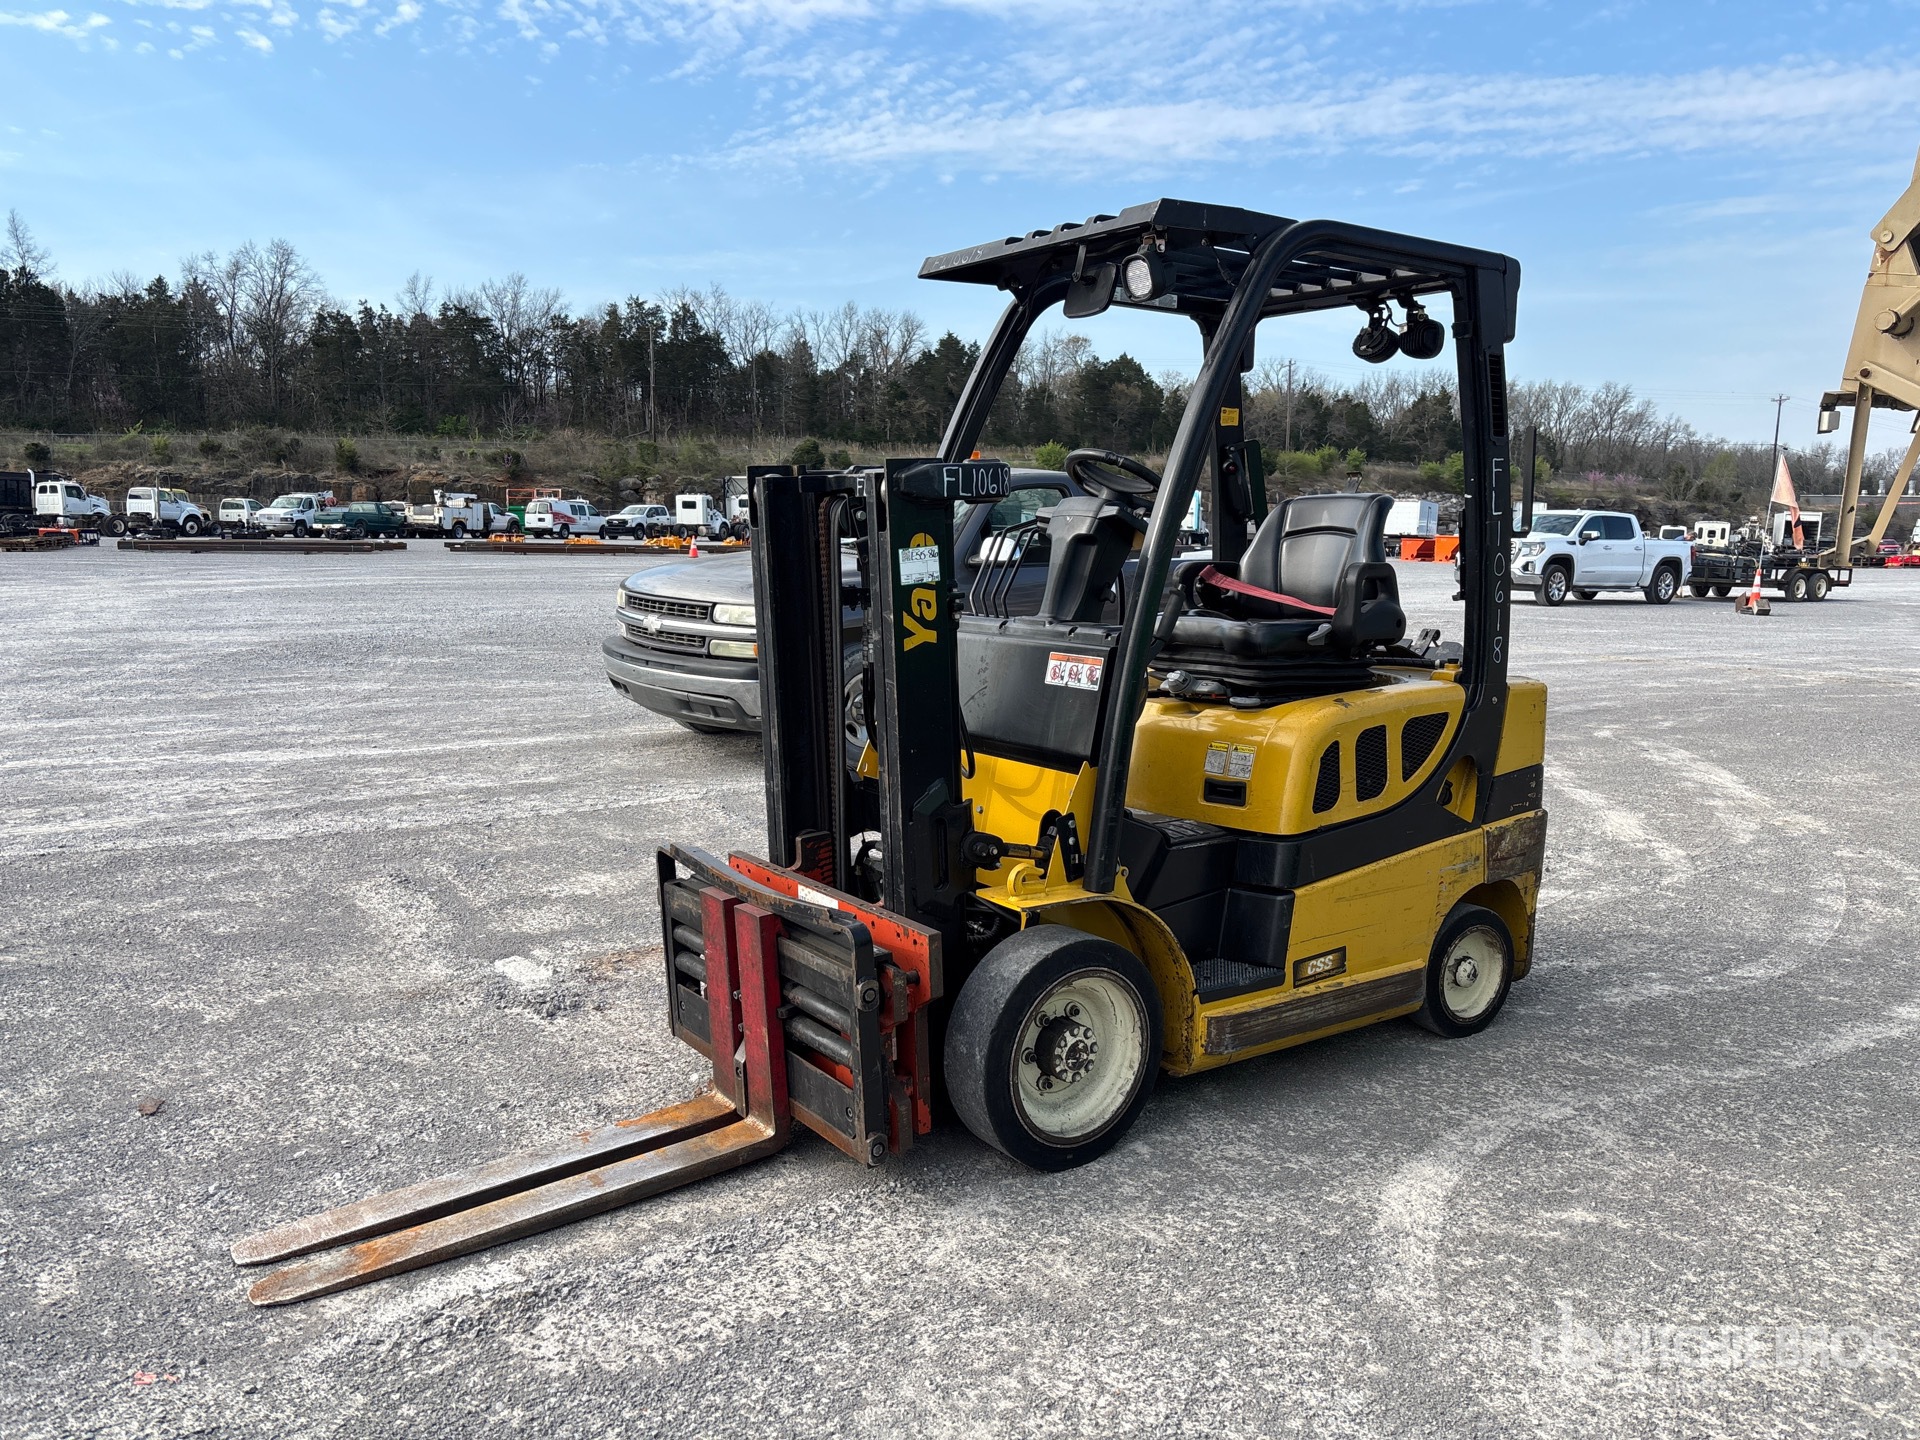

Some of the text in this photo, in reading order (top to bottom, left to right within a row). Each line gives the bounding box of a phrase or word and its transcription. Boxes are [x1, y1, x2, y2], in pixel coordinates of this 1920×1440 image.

[943, 466, 1010, 497] FL10618
[1491, 457, 1505, 664] FL10618
[1307, 955, 1333, 976] CSS
